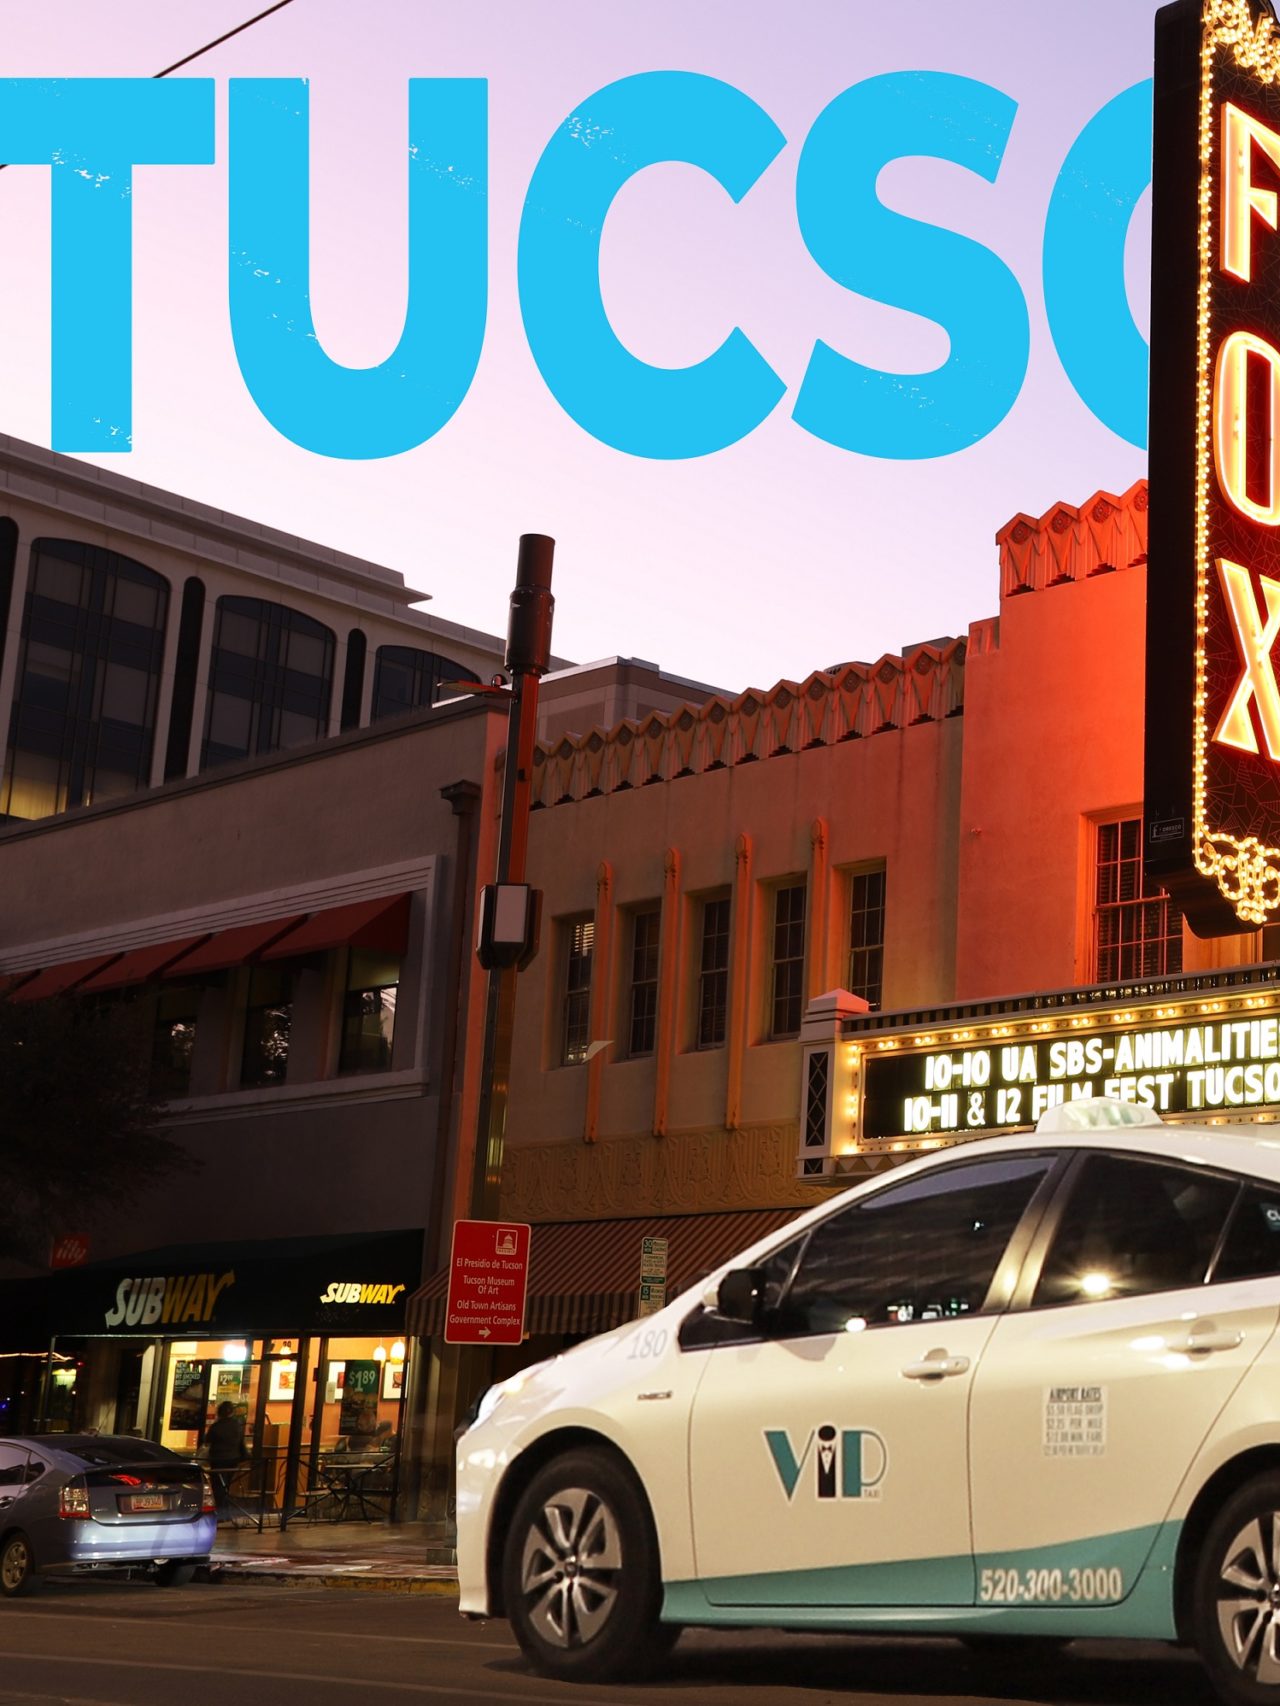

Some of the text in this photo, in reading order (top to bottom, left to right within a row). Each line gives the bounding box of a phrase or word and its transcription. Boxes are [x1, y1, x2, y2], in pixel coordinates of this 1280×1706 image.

[925, 1050, 991, 1090] 10-10
[1002, 1045, 1037, 1082] UA
[904, 1093, 958, 1132] 10-11
[967, 1092, 986, 1126] &
[997, 1088, 1022, 1124] 12
[456, 1257, 523, 1270] El Presidio de Tucson
[463, 1275, 515, 1286] Tucson Museum
[478, 1285, 499, 1295] Of Art
[105, 1269, 236, 1328] SUBWAY
[320, 1282, 405, 1305] SUBWAY
[457, 1300, 516, 1311] Old Town Artisans
[449, 1314, 520, 1327] Government Complex
[627, 1329, 668, 1360] 180
[980, 1567, 1122, 1601] 520-300-3000
